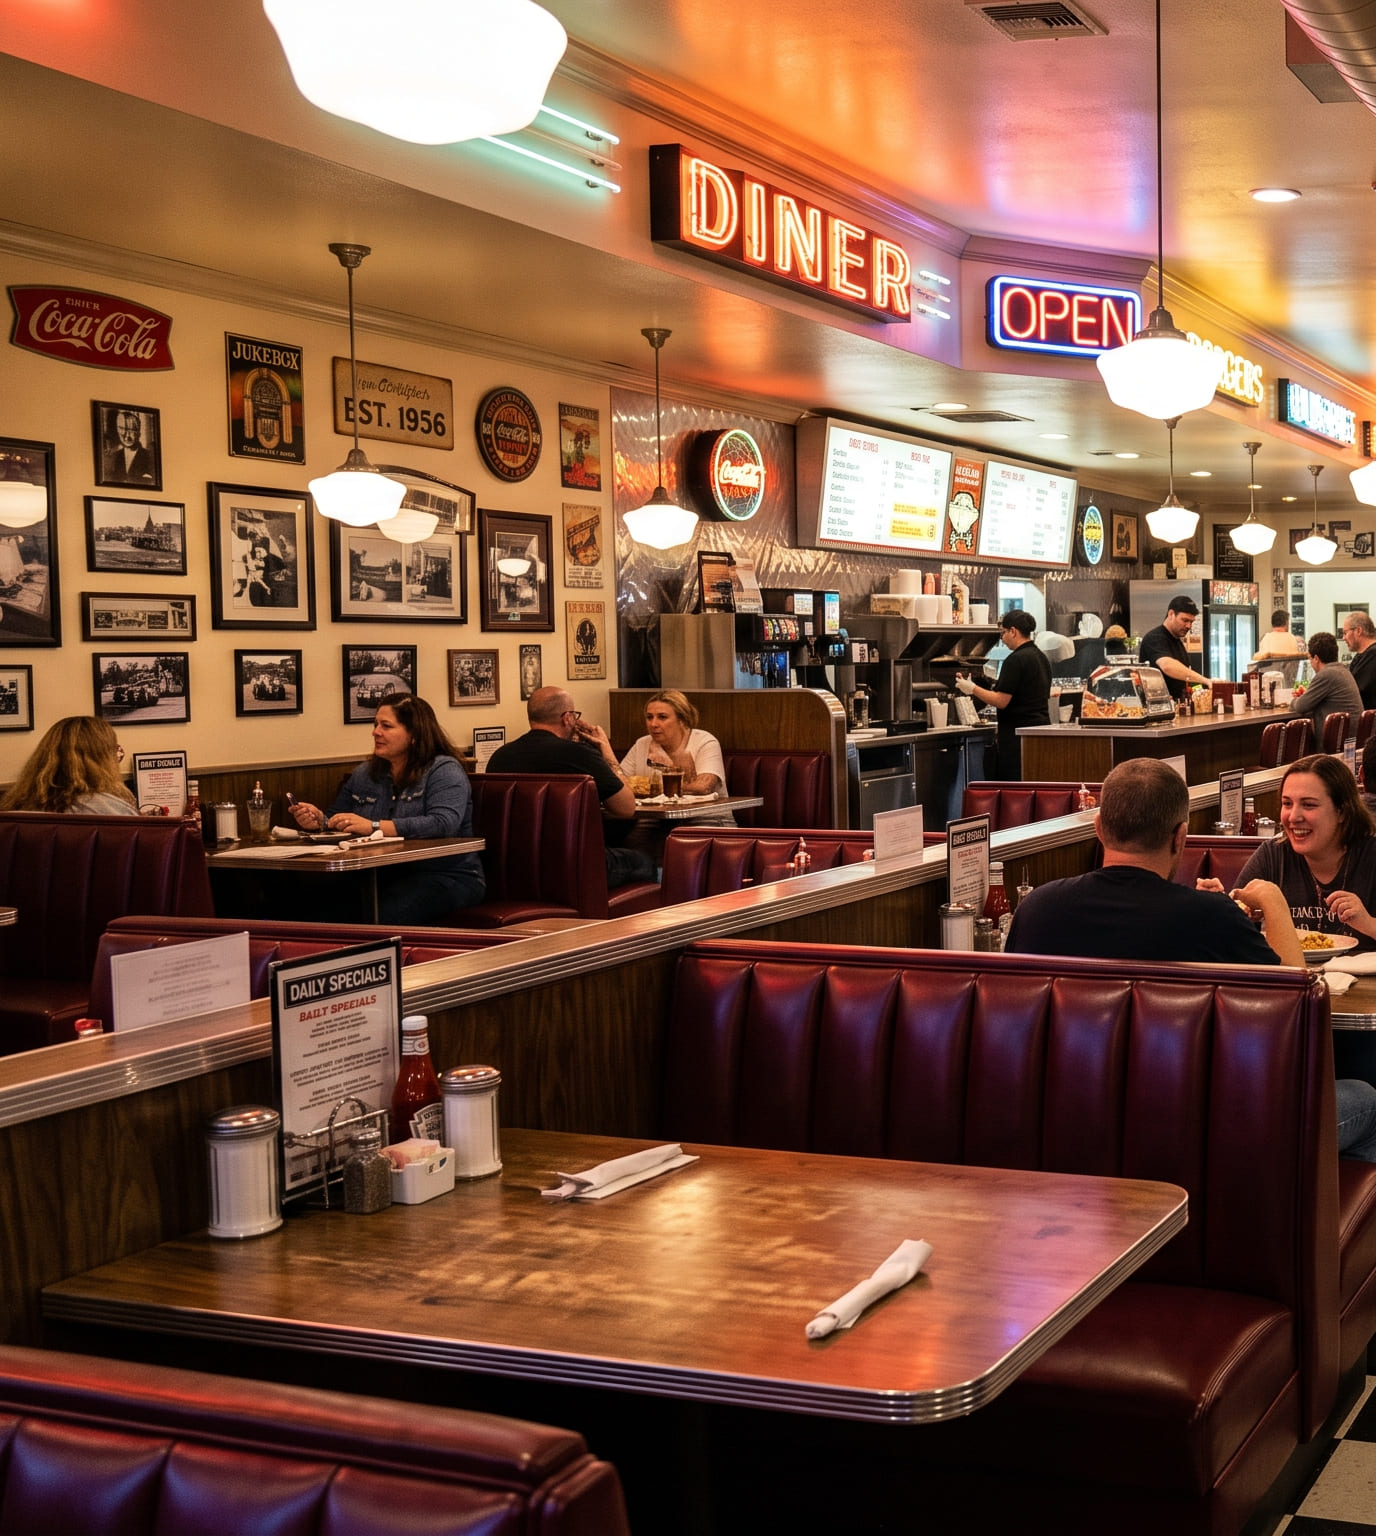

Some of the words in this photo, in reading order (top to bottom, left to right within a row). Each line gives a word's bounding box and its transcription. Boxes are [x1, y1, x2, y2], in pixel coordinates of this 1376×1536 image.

[690, 156, 912, 314] DINER
[28, 298, 161, 360] Coca-Cola
[1002, 287, 1134, 348] OPEN
[343, 396, 391, 428] EST.
[397, 406, 446, 437] 1956
[290, 977, 327, 1002] DAILY
[329, 964, 387, 992] SPECIALS
